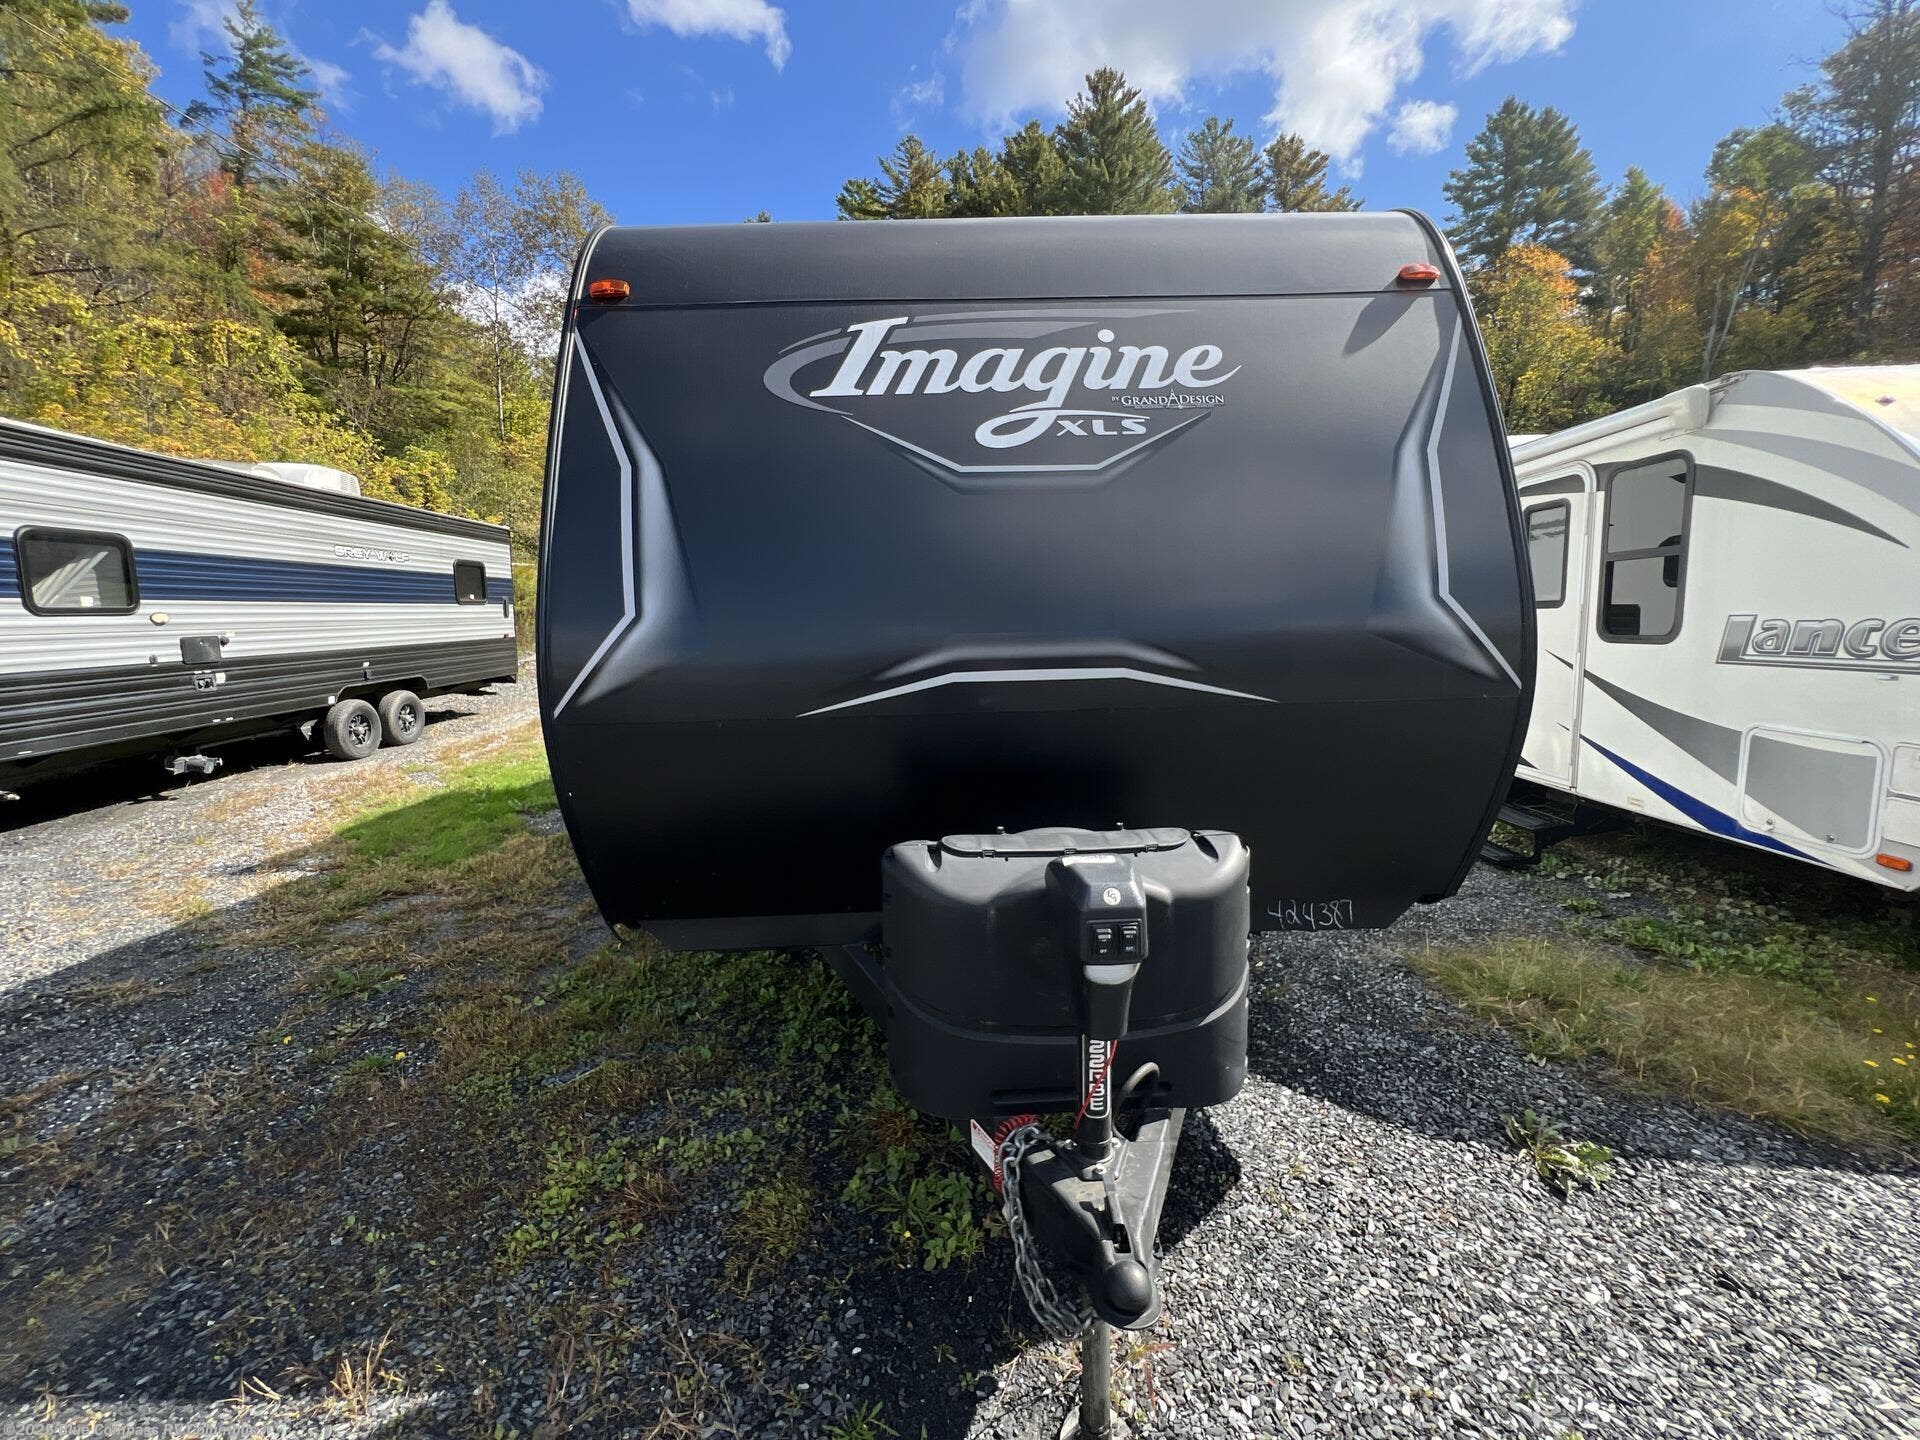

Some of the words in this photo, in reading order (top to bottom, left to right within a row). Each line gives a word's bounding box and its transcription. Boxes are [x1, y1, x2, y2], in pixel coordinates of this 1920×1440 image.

[809, 316, 1242, 448] Imagine
[1056, 417, 1147, 436] XLS
[1267, 899, 1353, 929] 424387
